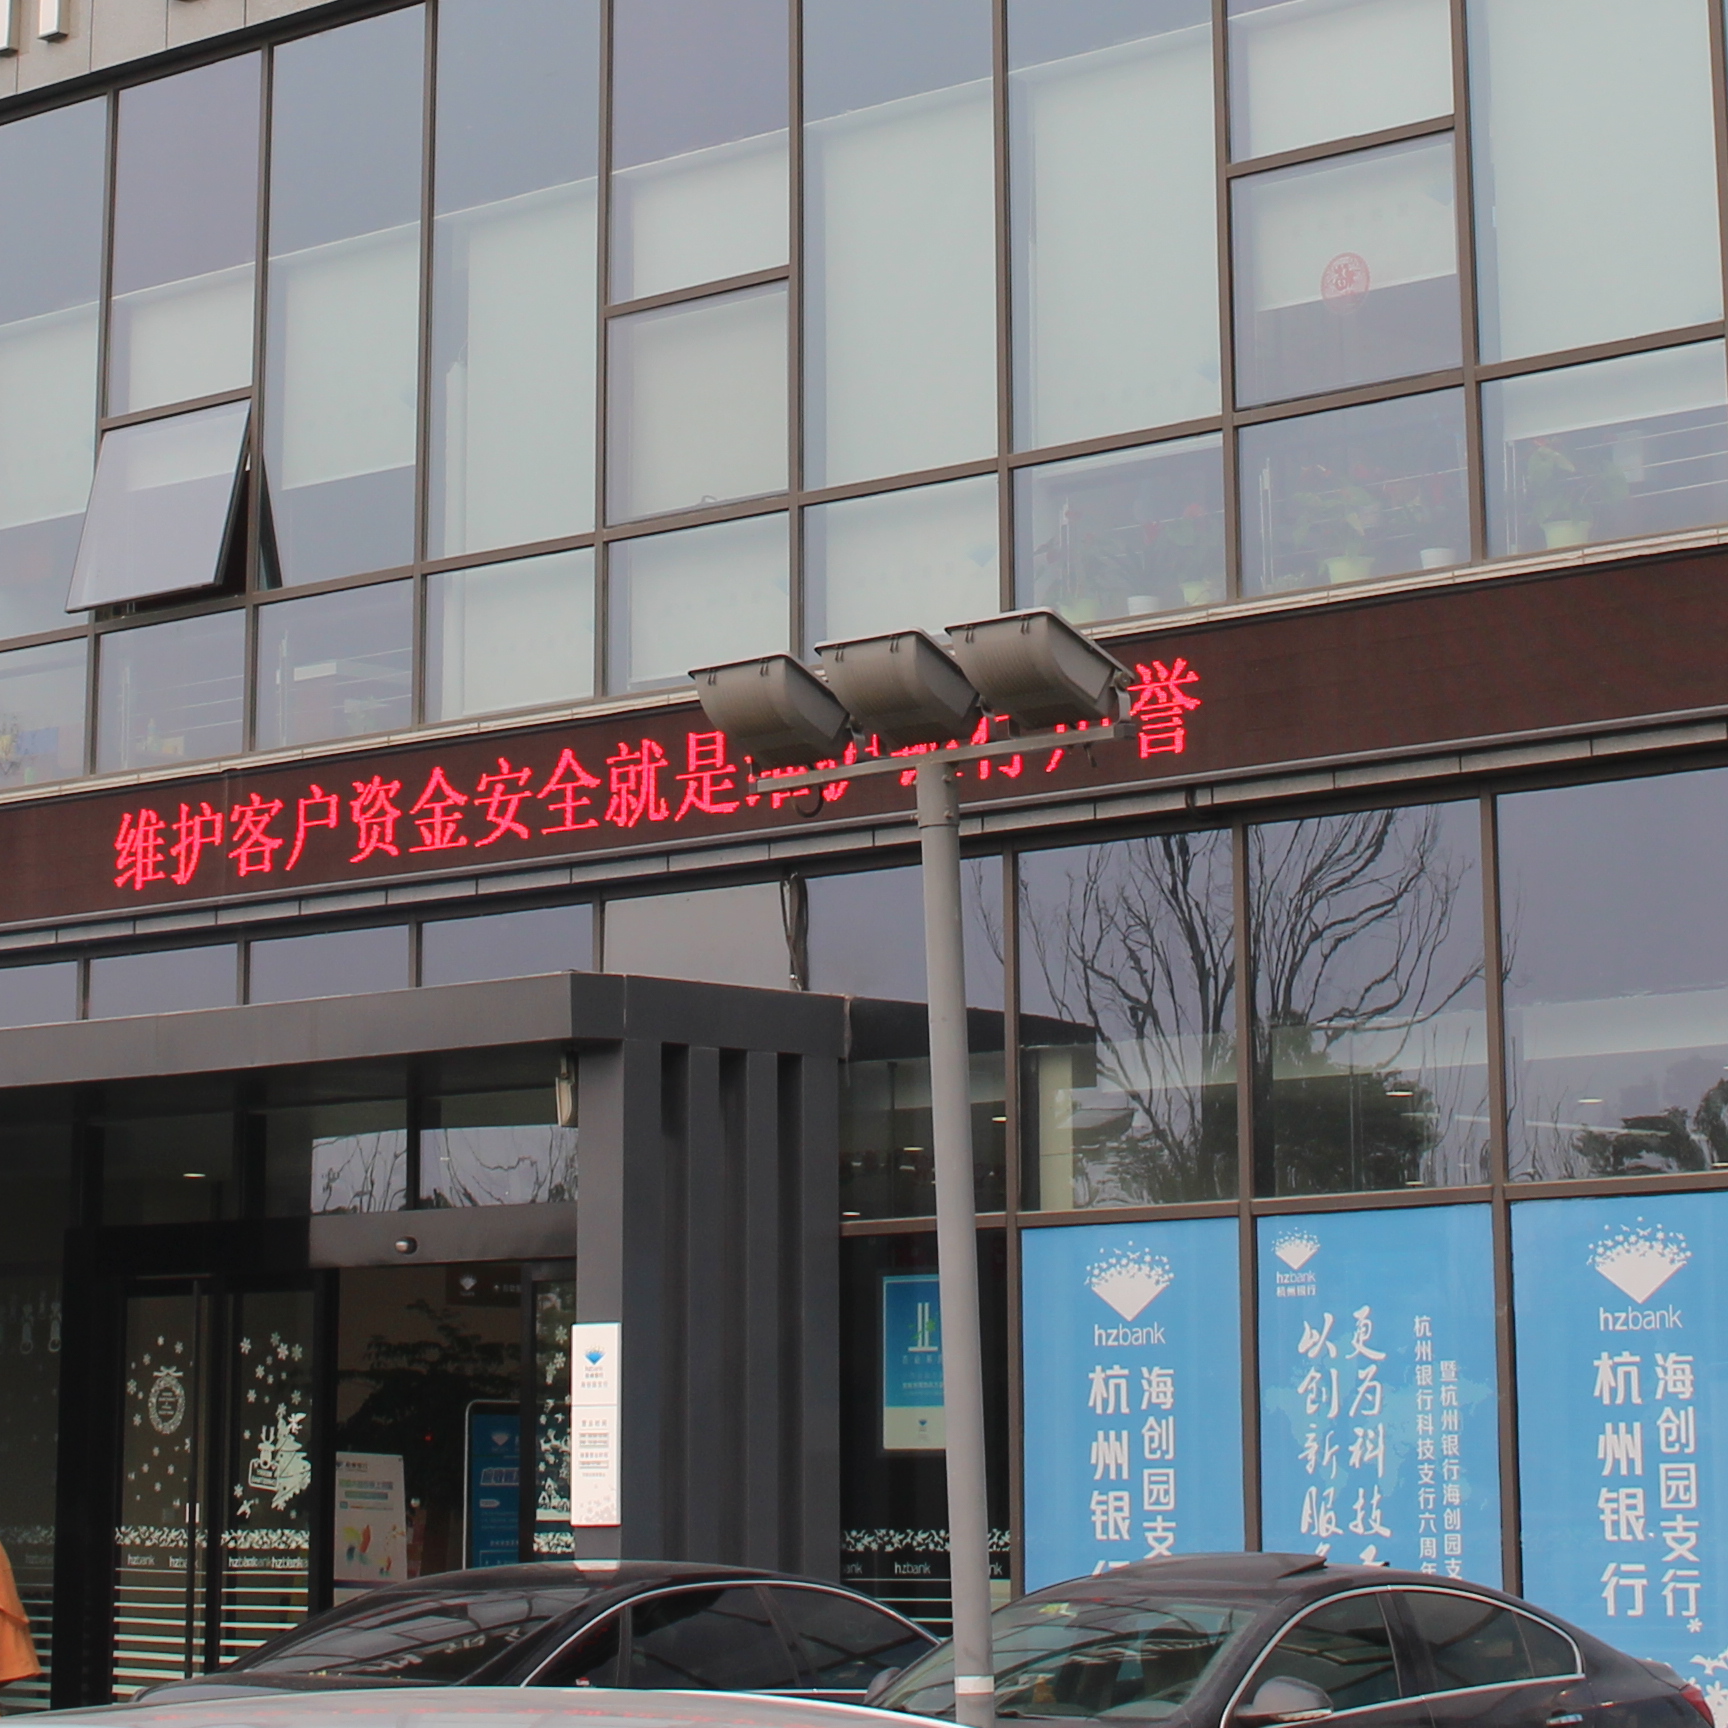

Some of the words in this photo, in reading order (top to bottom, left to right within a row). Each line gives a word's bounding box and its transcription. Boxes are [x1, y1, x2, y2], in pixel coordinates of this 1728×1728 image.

[114, 658, 1201, 890] 维护客户资金安全就是誉
[1276, 1271, 1317, 1284] hzbank
[1276, 1285, 1317, 1297] 杭州银行
[1599, 1305, 1683, 1331] hzbank
[1094, 1322, 1167, 1346] hzbank
[1593, 1351, 1648, 1616] 杭州银行
[1654, 1352, 1701, 1617] 海创园支行
[894, 1560, 932, 1575] hzbank
